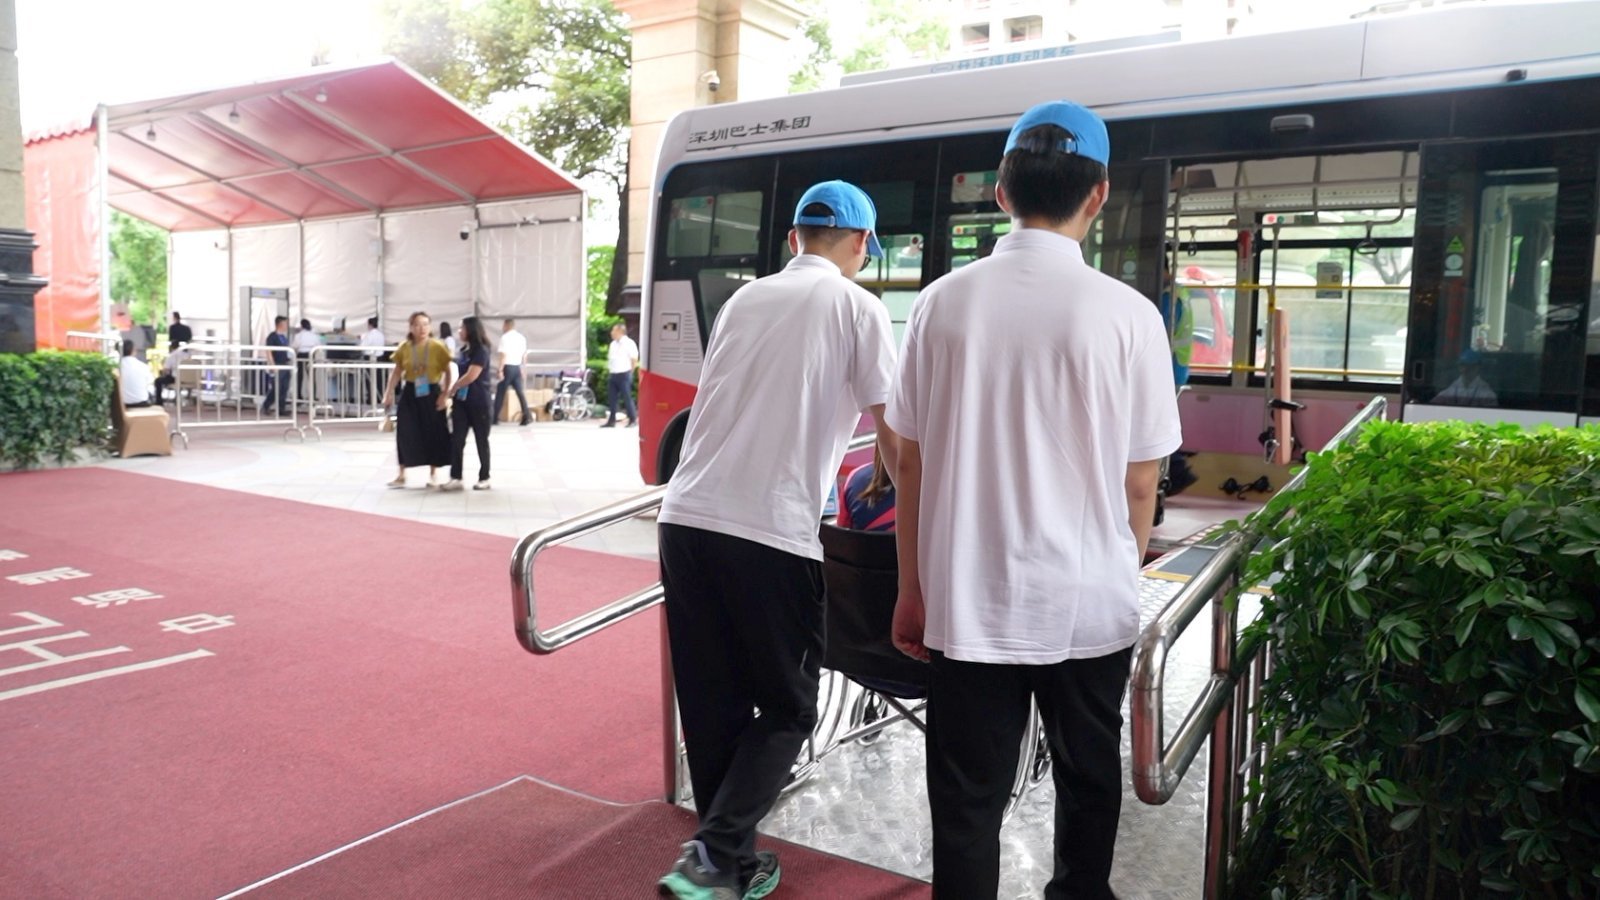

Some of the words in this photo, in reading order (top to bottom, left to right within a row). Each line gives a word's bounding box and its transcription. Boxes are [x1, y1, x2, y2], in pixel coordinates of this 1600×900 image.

[688, 116, 811, 144] 深圳巴士集团
